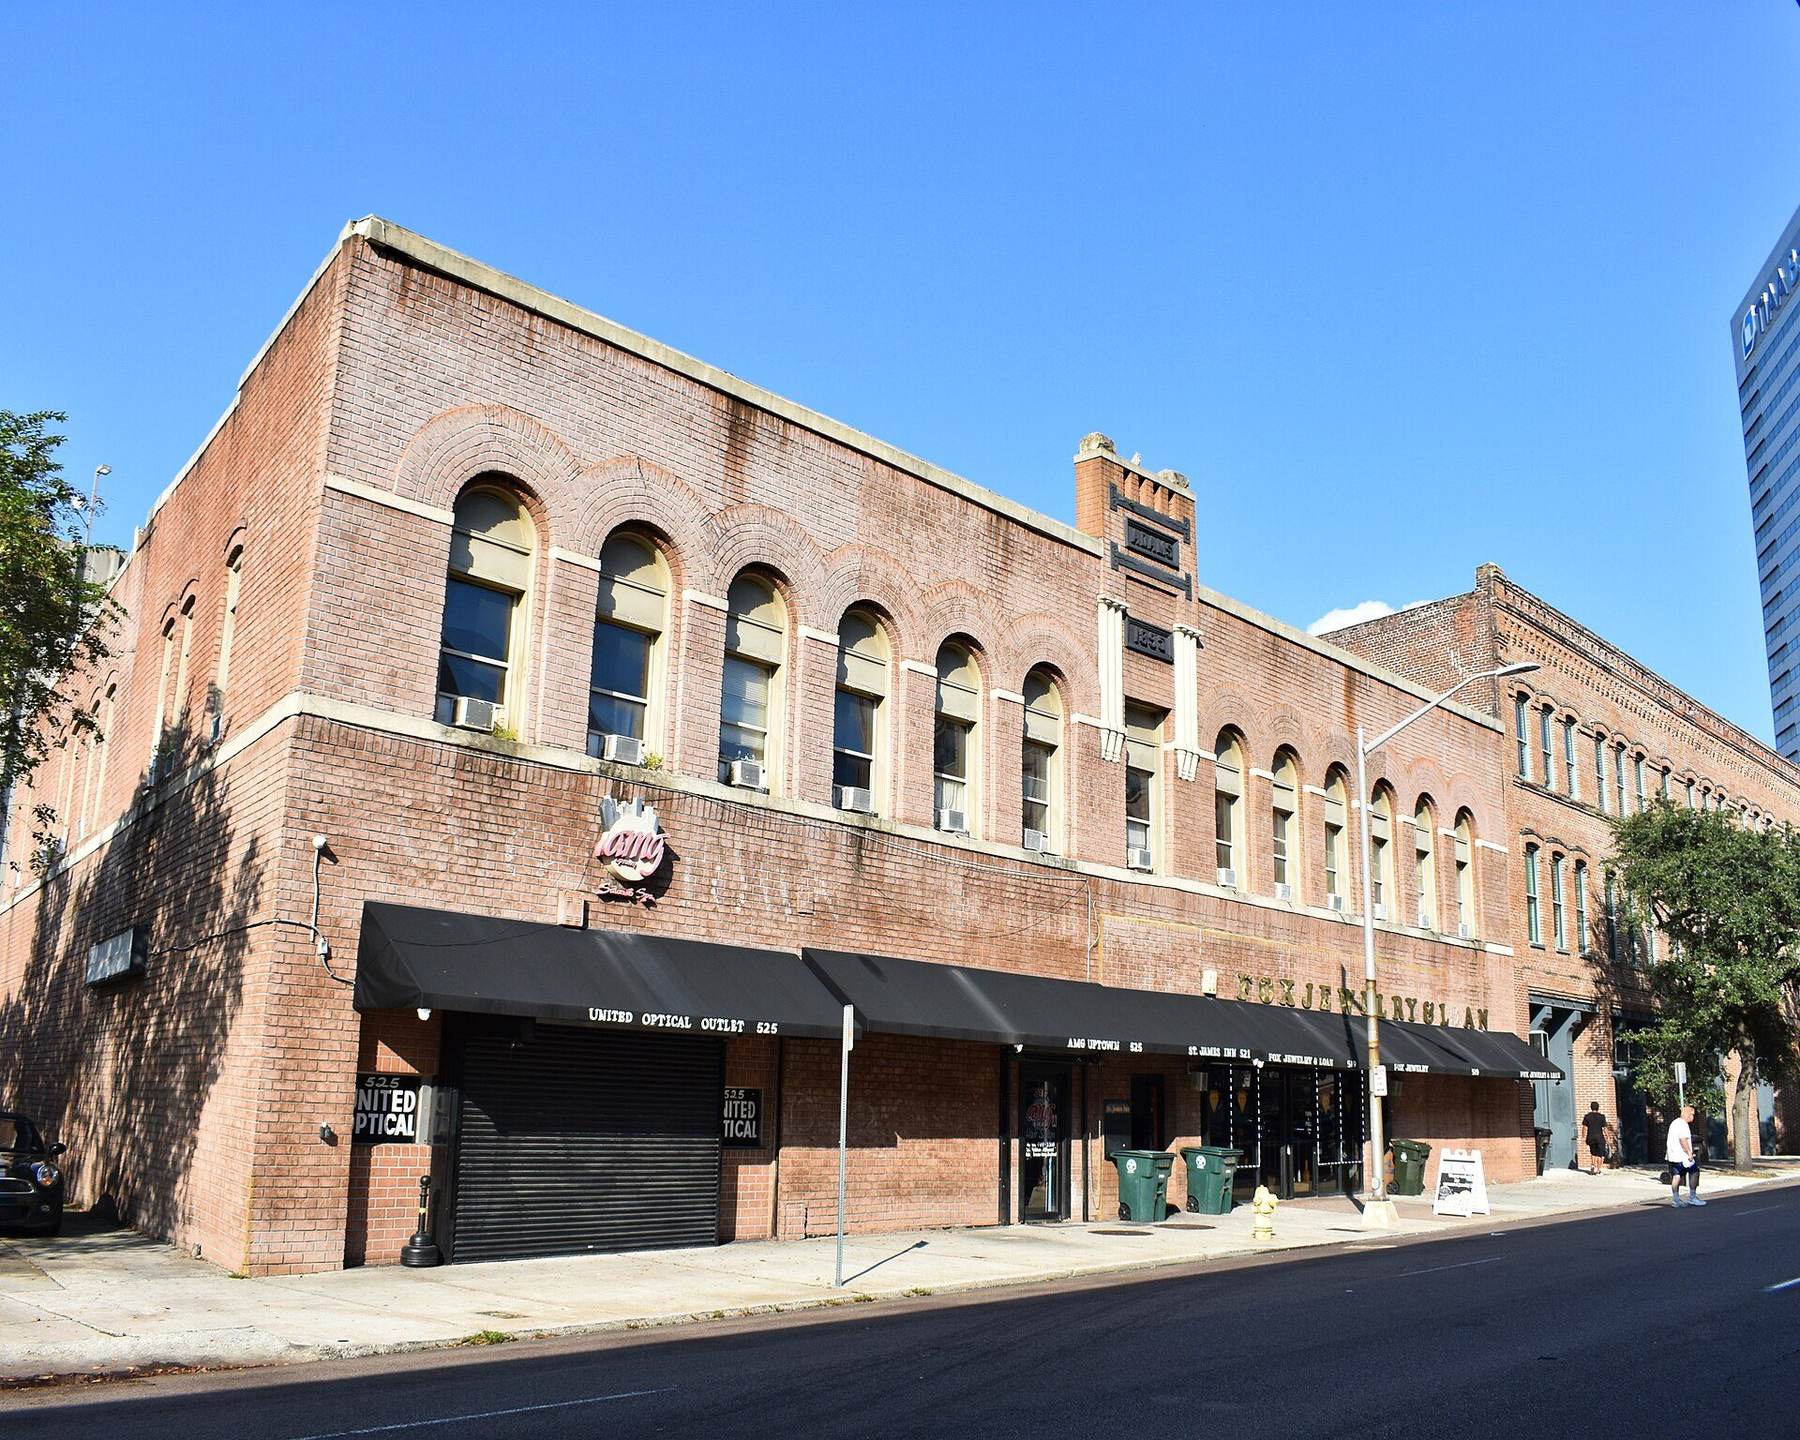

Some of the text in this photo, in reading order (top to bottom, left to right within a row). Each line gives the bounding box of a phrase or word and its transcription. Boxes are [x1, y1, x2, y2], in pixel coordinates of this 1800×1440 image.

[1235, 971, 1296, 1007] FOX
[588, 1007, 778, 1034] UNITED OPTICAL OUTLET 525
[1067, 1037, 1143, 1052] AMG UPTOWN 525
[1199, 1046, 1221, 1057] JAMES
[1224, 1047, 1237, 1058] INN
[1240, 1048, 1251, 1059] 521
[1268, 1053, 1281, 1063] FOX
[1283, 1054, 1312, 1065] JEWELRY
[1319, 1057, 1334, 1067] LOAN
[1393, 1063, 1429, 1073] FOX JEWELRY
[365, 1076, 400, 1089] 525
[355, 1088, 417, 1113] NITED
[724, 1089, 745, 1100] 525
[354, 1112, 415, 1137] PTICAL
[723, 1119, 757, 1138] TICAL
